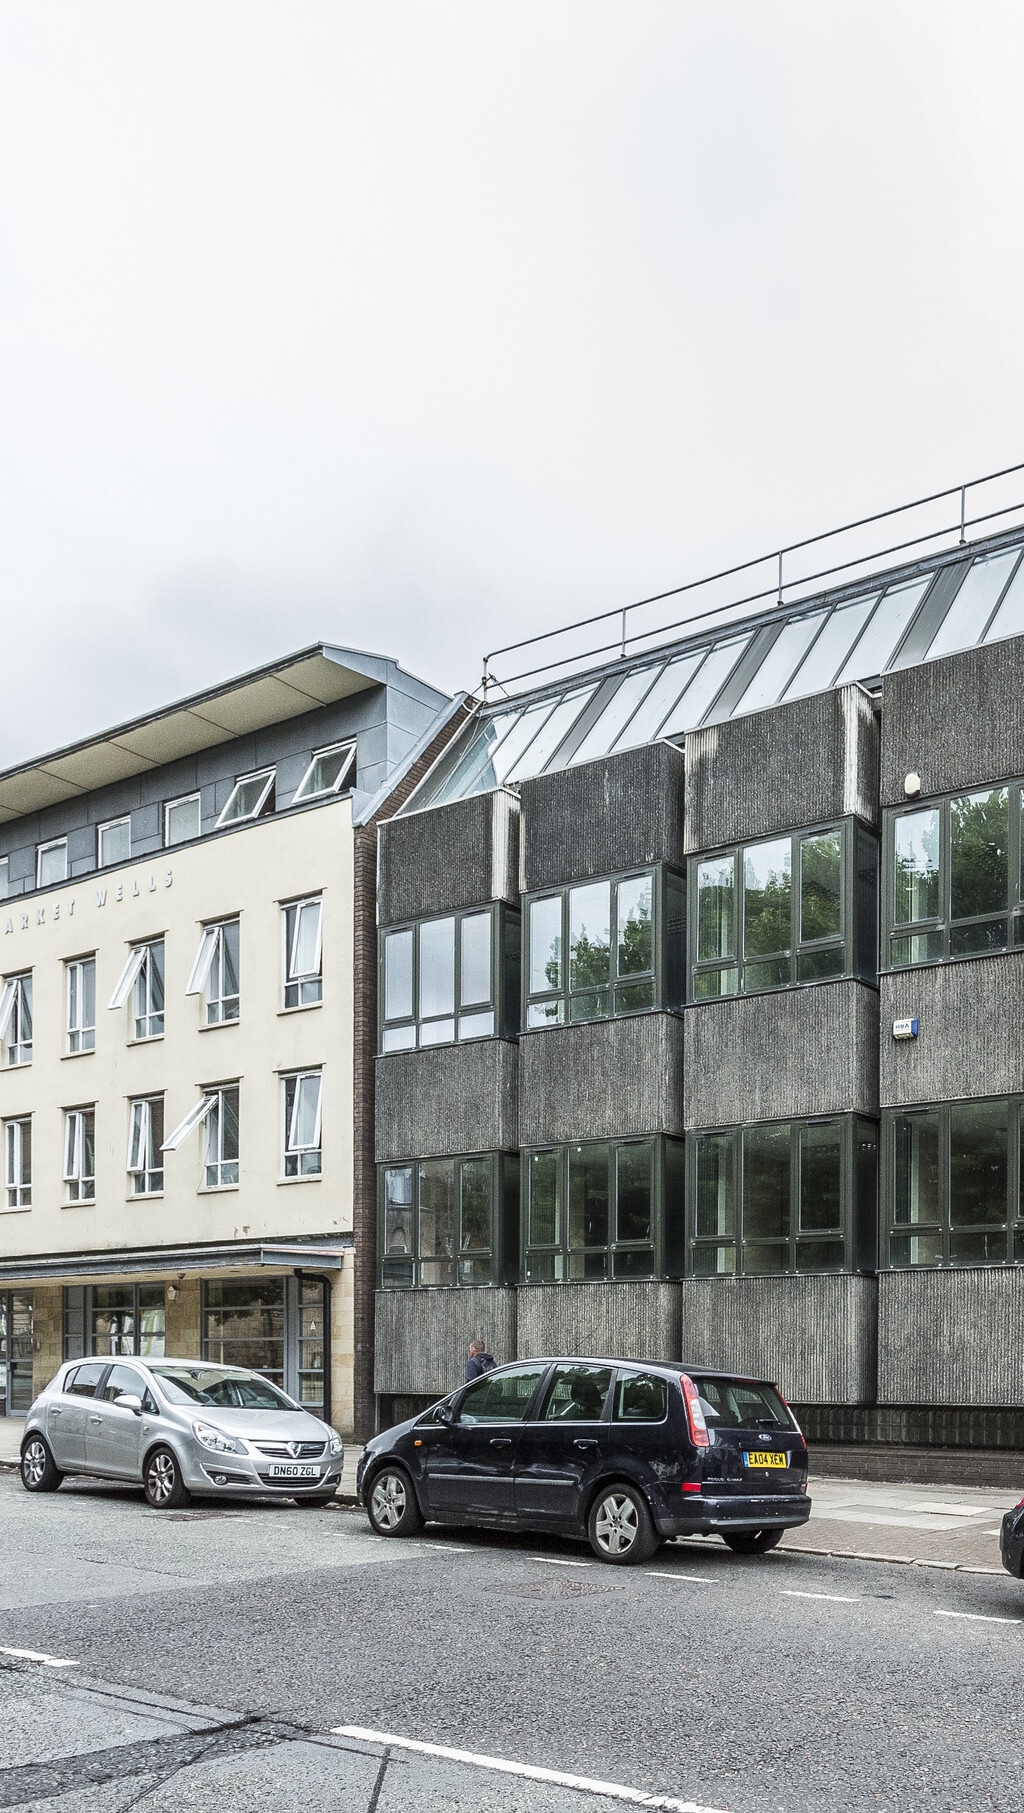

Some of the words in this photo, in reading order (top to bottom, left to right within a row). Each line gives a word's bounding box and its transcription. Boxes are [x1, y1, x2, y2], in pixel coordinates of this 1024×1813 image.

[96, 870, 173, 907] WELLS
[748, 1453, 769, 1465] EA04
[273, 1466, 298, 1476] DN60
[300, 1466, 316, 1476] ZGL
